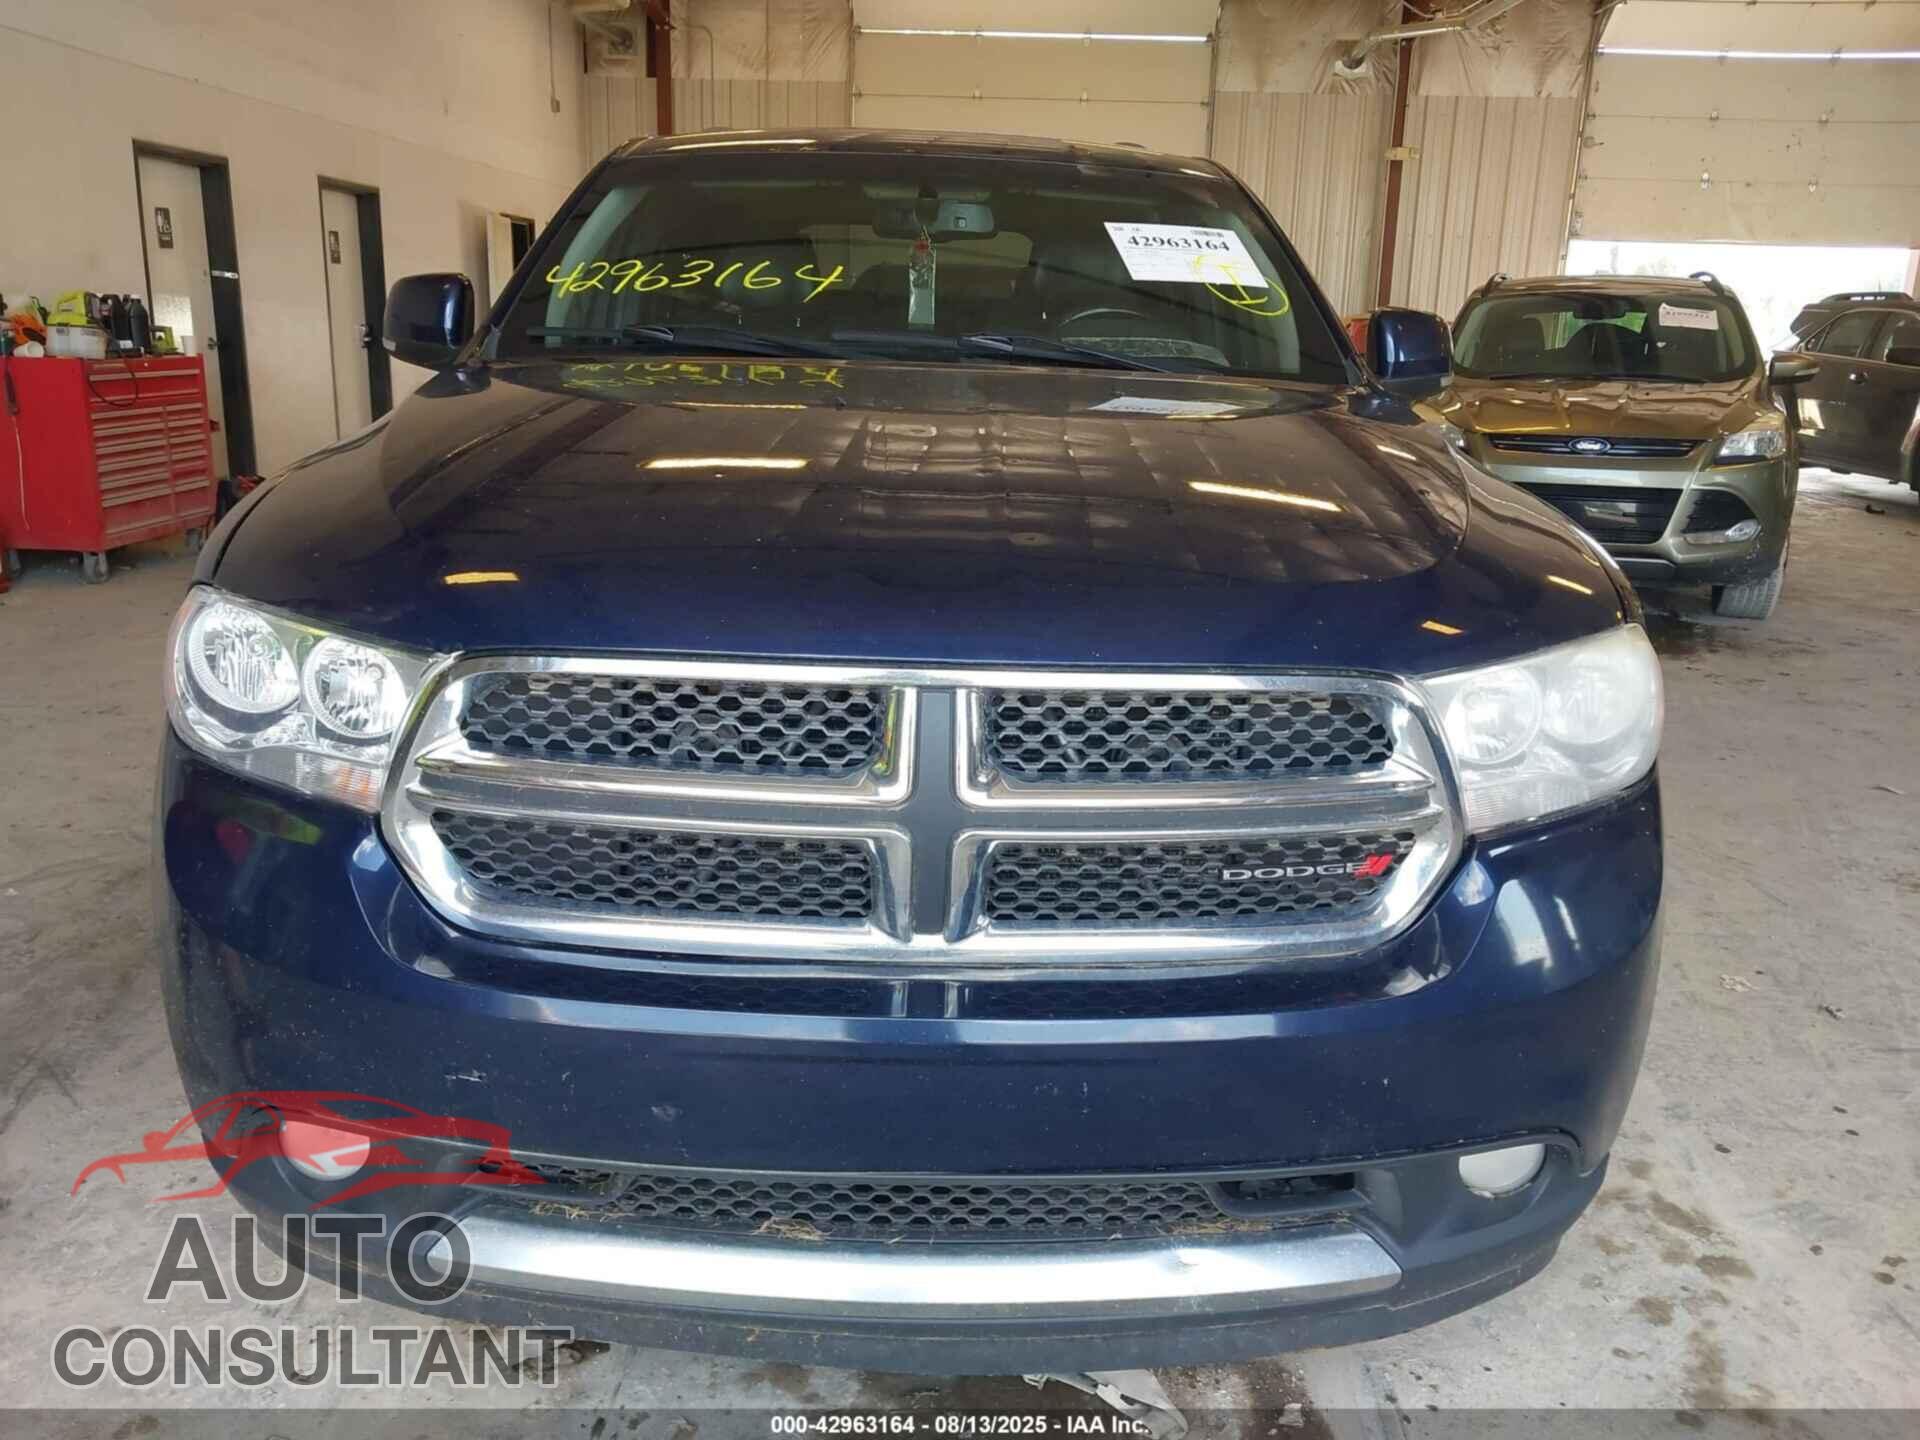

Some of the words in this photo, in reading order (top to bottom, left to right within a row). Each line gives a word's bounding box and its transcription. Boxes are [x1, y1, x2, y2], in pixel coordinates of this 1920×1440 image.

[1127, 235, 1231, 251] 42963164
[545, 259, 846, 303] 42963164
[1222, 862, 1372, 881] DODGE
